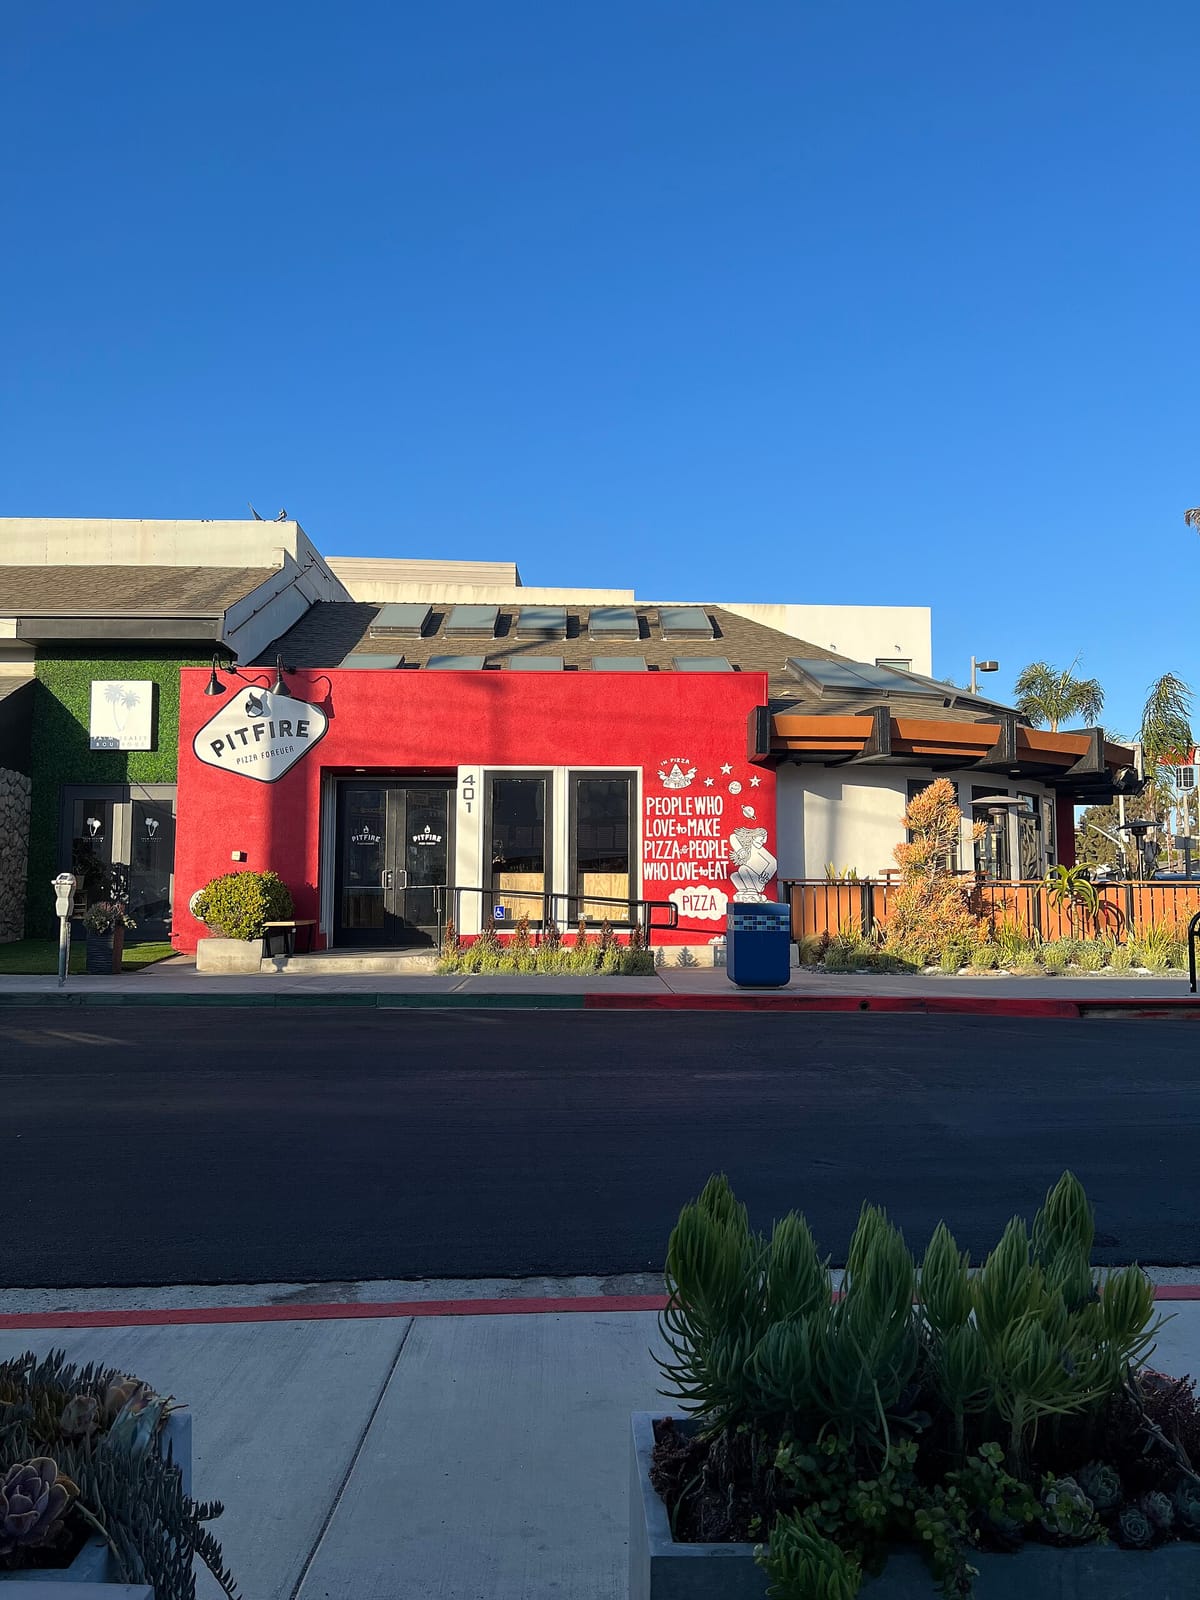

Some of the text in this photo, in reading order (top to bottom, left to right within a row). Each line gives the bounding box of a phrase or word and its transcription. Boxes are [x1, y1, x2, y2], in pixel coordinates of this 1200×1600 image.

[210, 719, 310, 758] PITFIRE
[236, 753, 258, 765] PIZZA
[660, 757, 690, 767] IN PIZZA
[462, 774, 476, 813] 401
[645, 795, 724, 816] PEOPLE WHO
[645, 818, 721, 837] LOVE to MAKE
[351, 834, 381, 843] PITFIRE
[412, 834, 442, 843] PITFIRE
[644, 840, 681, 859] PIZZA
[689, 839, 729, 859] PEOPLE
[643, 861, 729, 881] WHO LOVE to EAT
[682, 894, 717, 911] PIZZA
